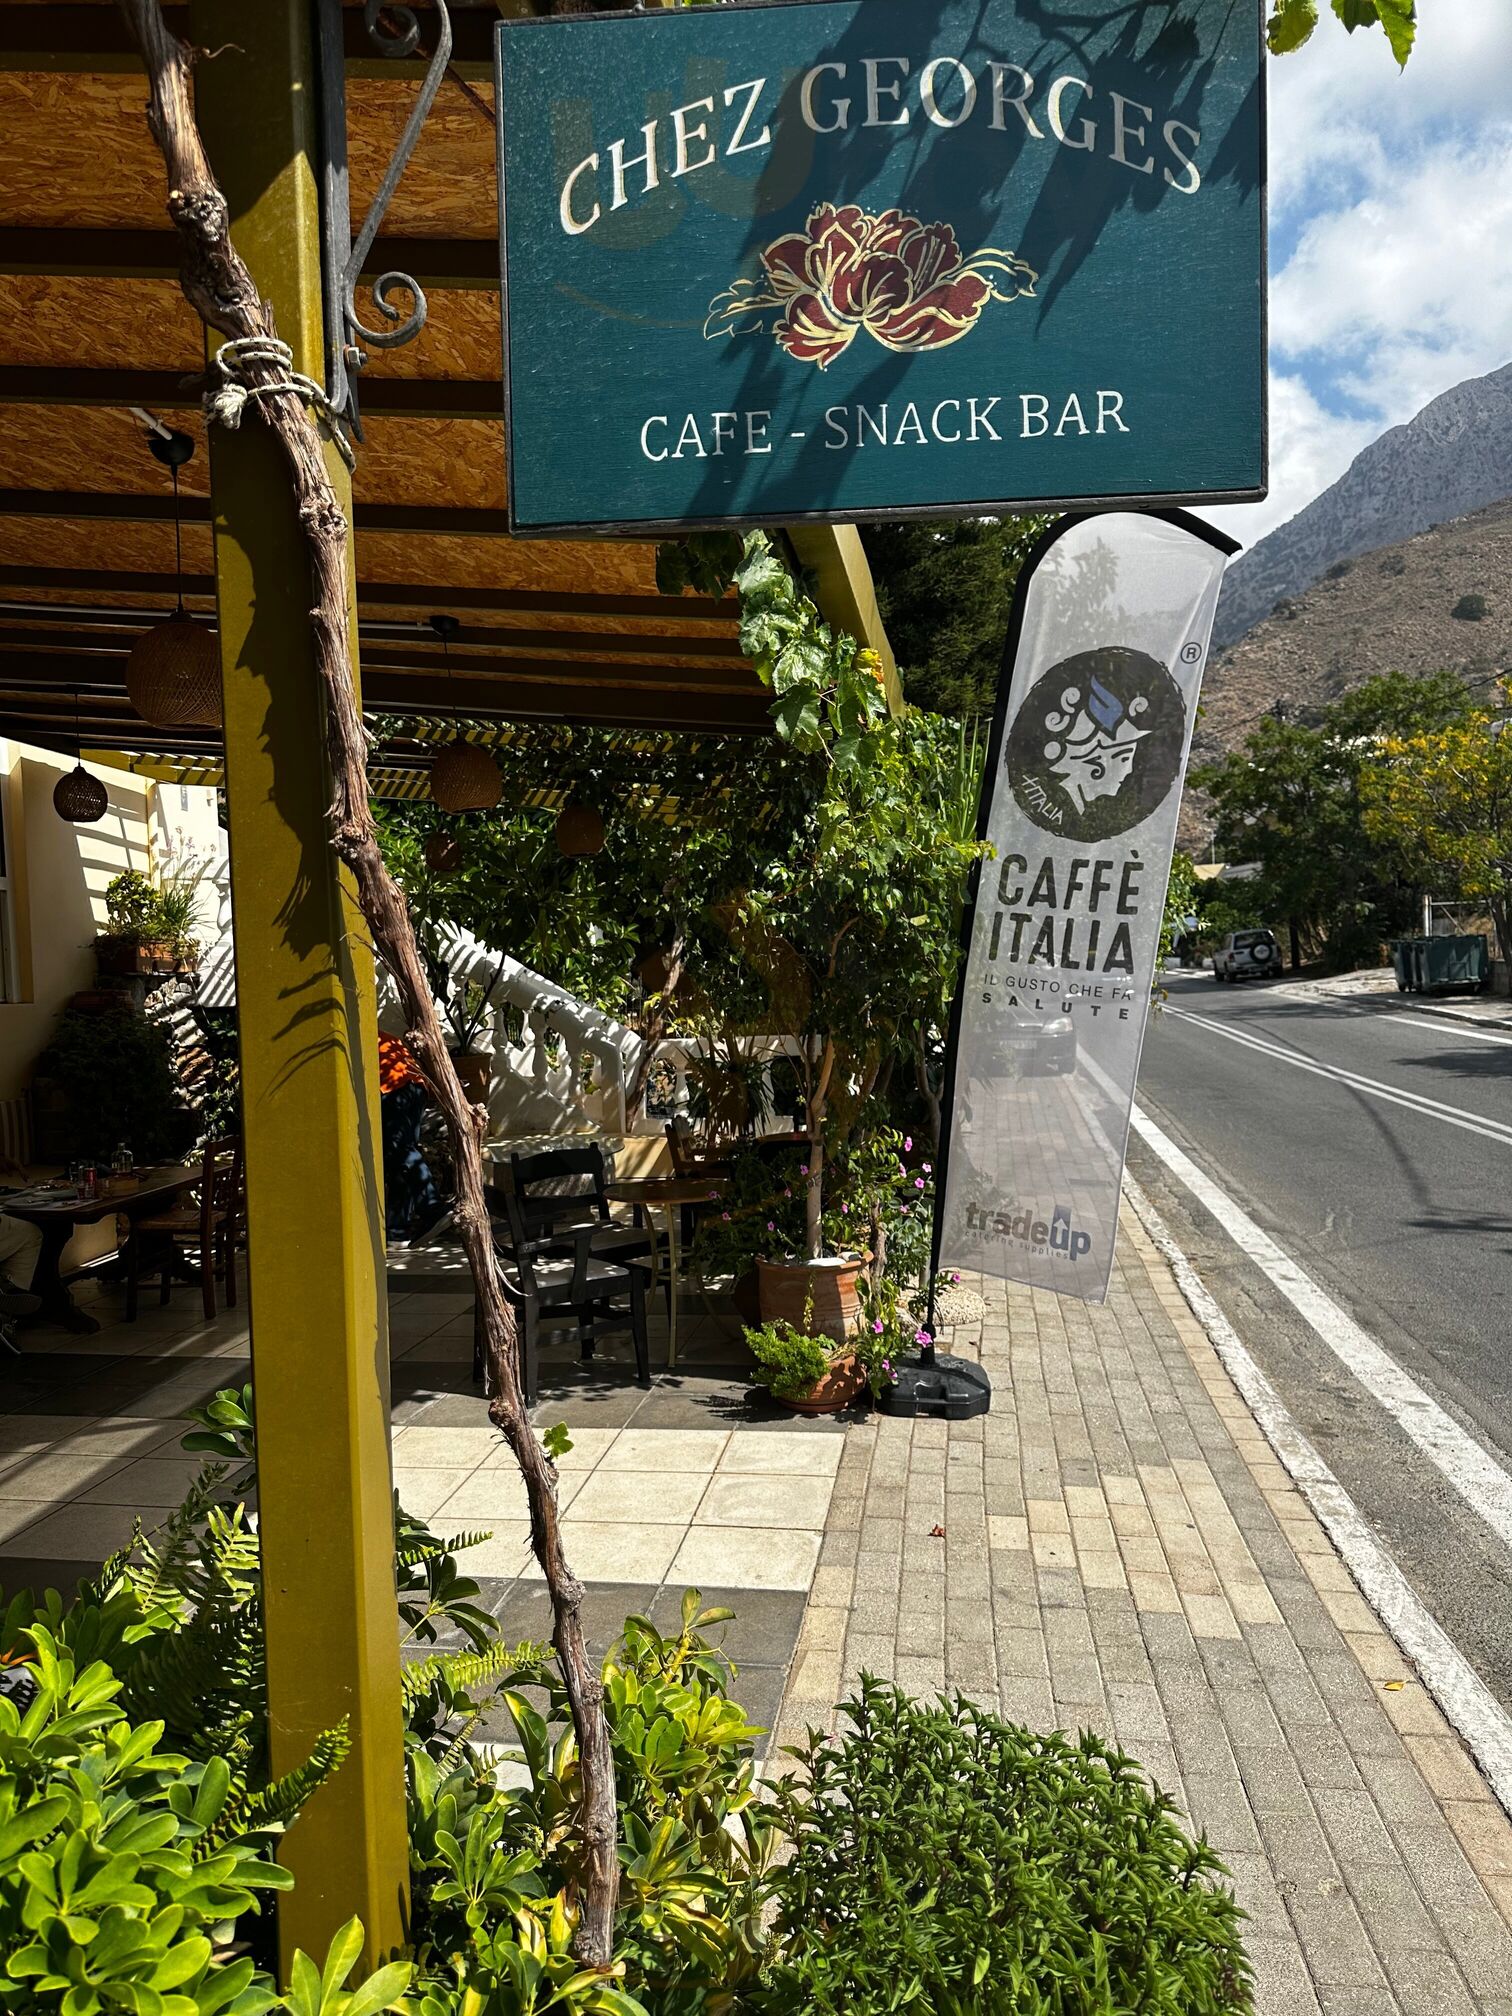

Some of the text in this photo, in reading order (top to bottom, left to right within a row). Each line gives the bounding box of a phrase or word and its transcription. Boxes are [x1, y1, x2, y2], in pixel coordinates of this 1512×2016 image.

[559, 57, 1202, 235] CHEZ GEORGES
[640, 410, 772, 463] CAFE
[823, 397, 1003, 450] SNACK
[1019, 390, 1131, 438] BAR
[998, 850, 1144, 915] CAFFÈ
[989, 911, 1134, 975] ITALIA
[984, 974, 1131, 1000] IL GUSTO CHE FA
[965, 1230, 1068, 1260] catering supplies
